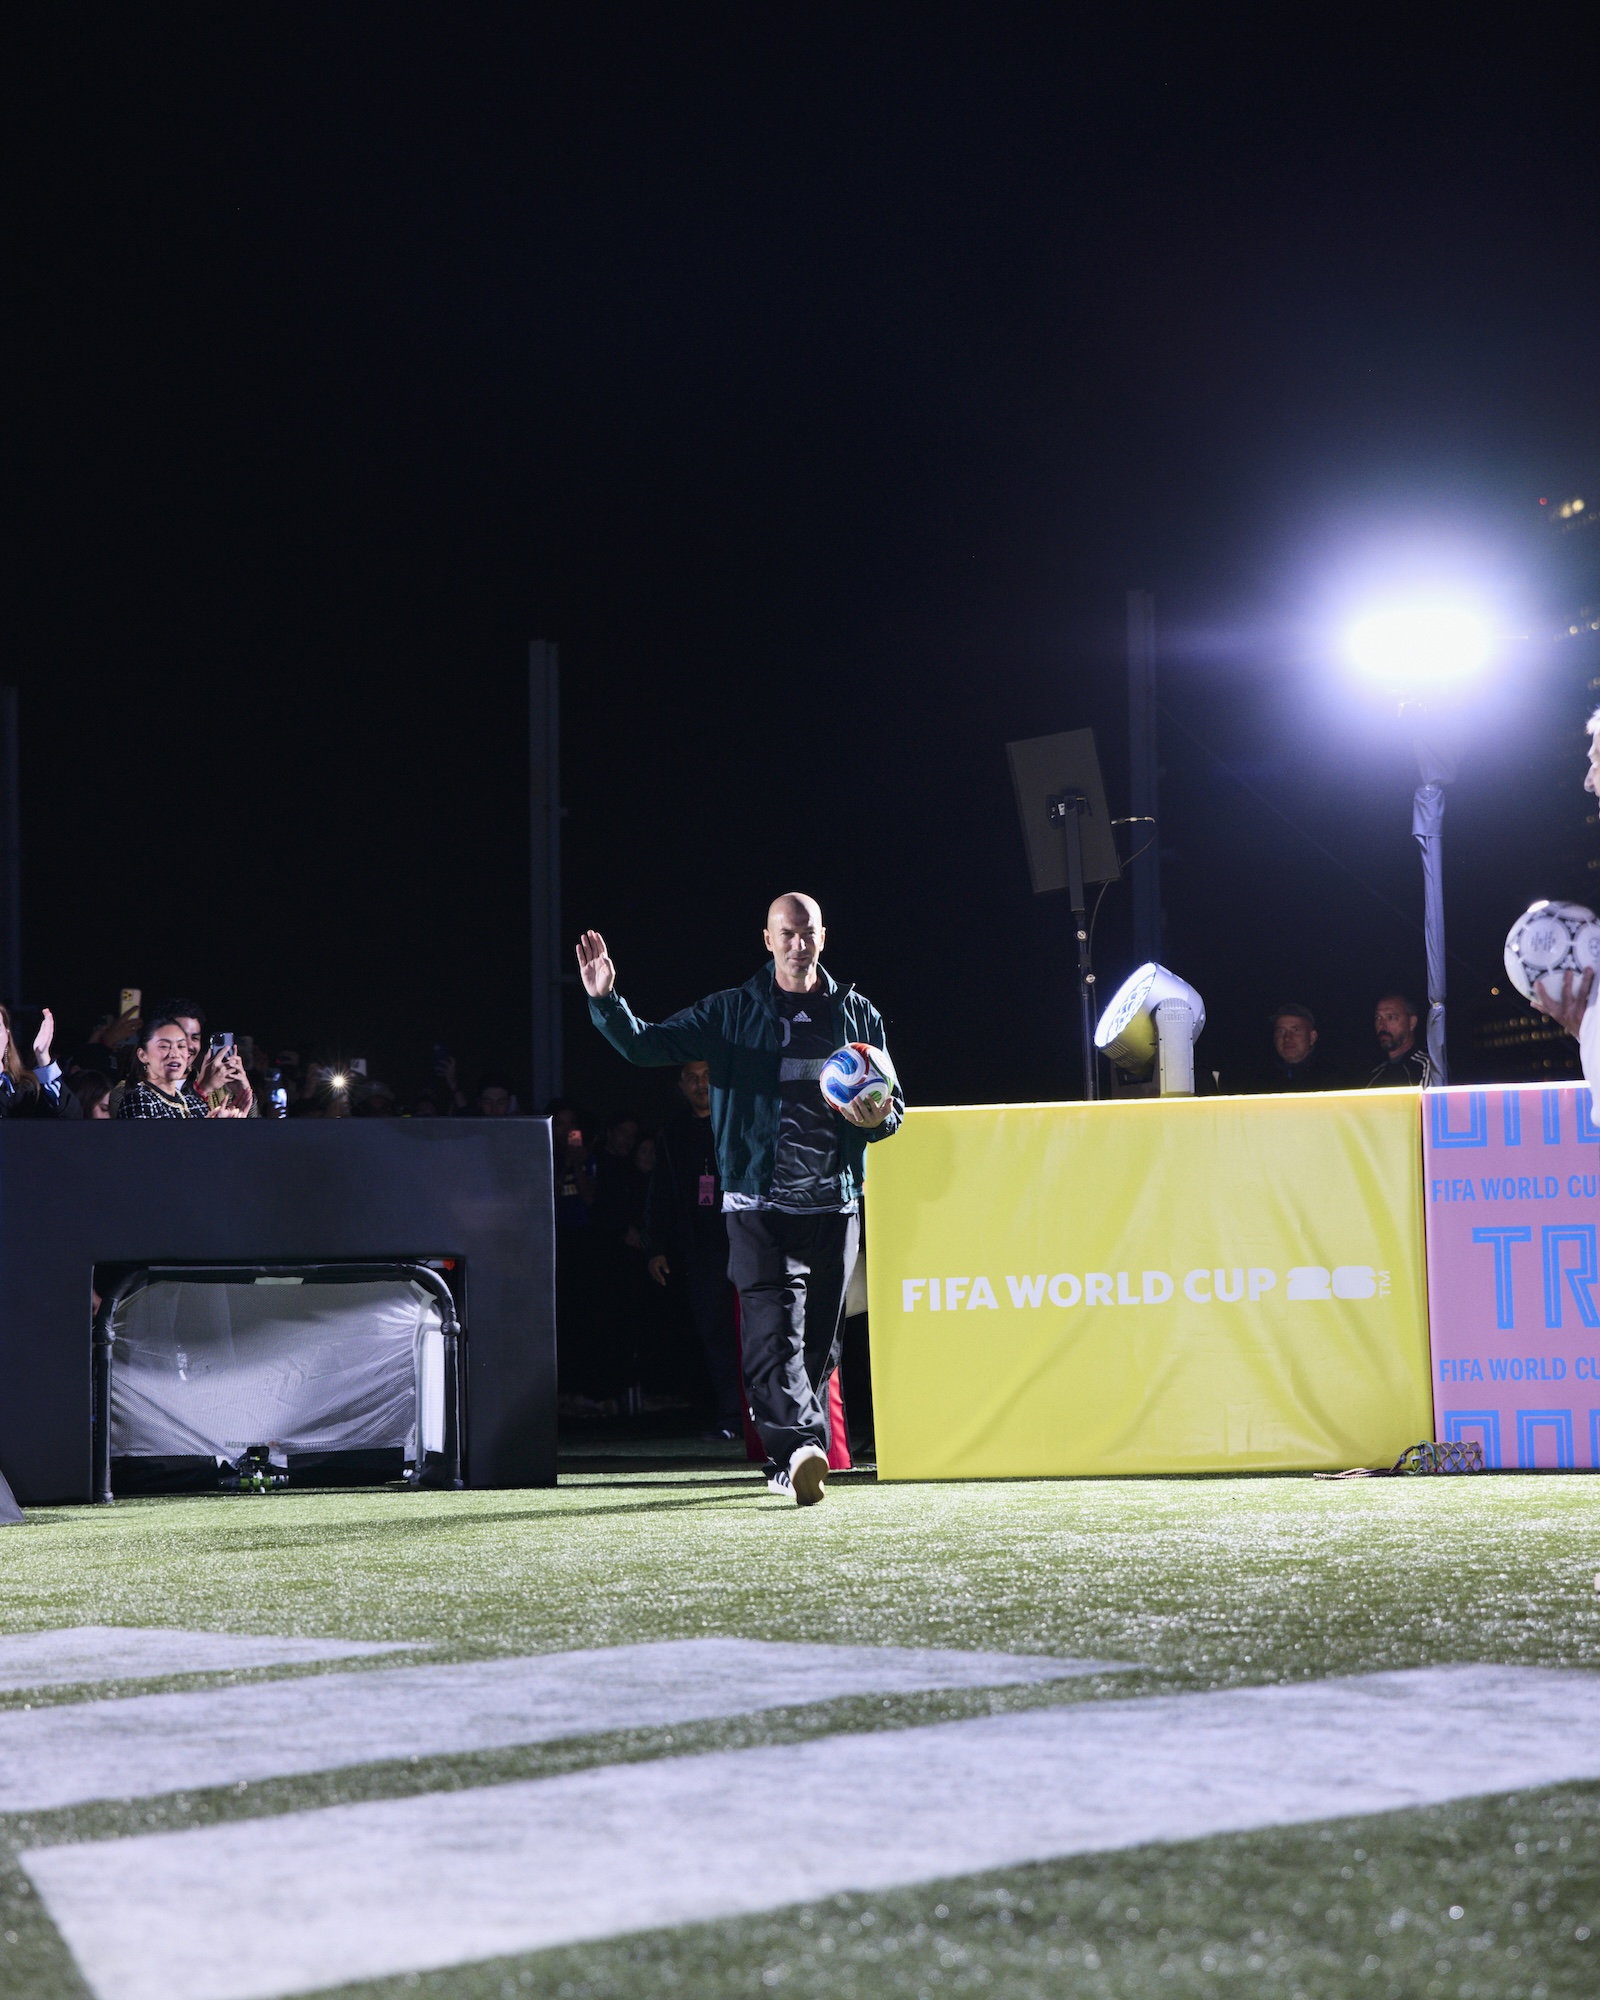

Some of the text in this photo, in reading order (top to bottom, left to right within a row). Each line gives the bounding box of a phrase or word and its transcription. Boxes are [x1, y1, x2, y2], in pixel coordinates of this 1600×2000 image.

[1431, 1174, 1600, 1202] FIFA WORLD CU
[902, 1276, 999, 1312] FIFA
[1005, 1270, 1174, 1308] WORLD
[1184, 1267, 1277, 1304] CUP
[1439, 1359, 1484, 1382] FIFA
[1488, 1357, 1566, 1381] WORLD
